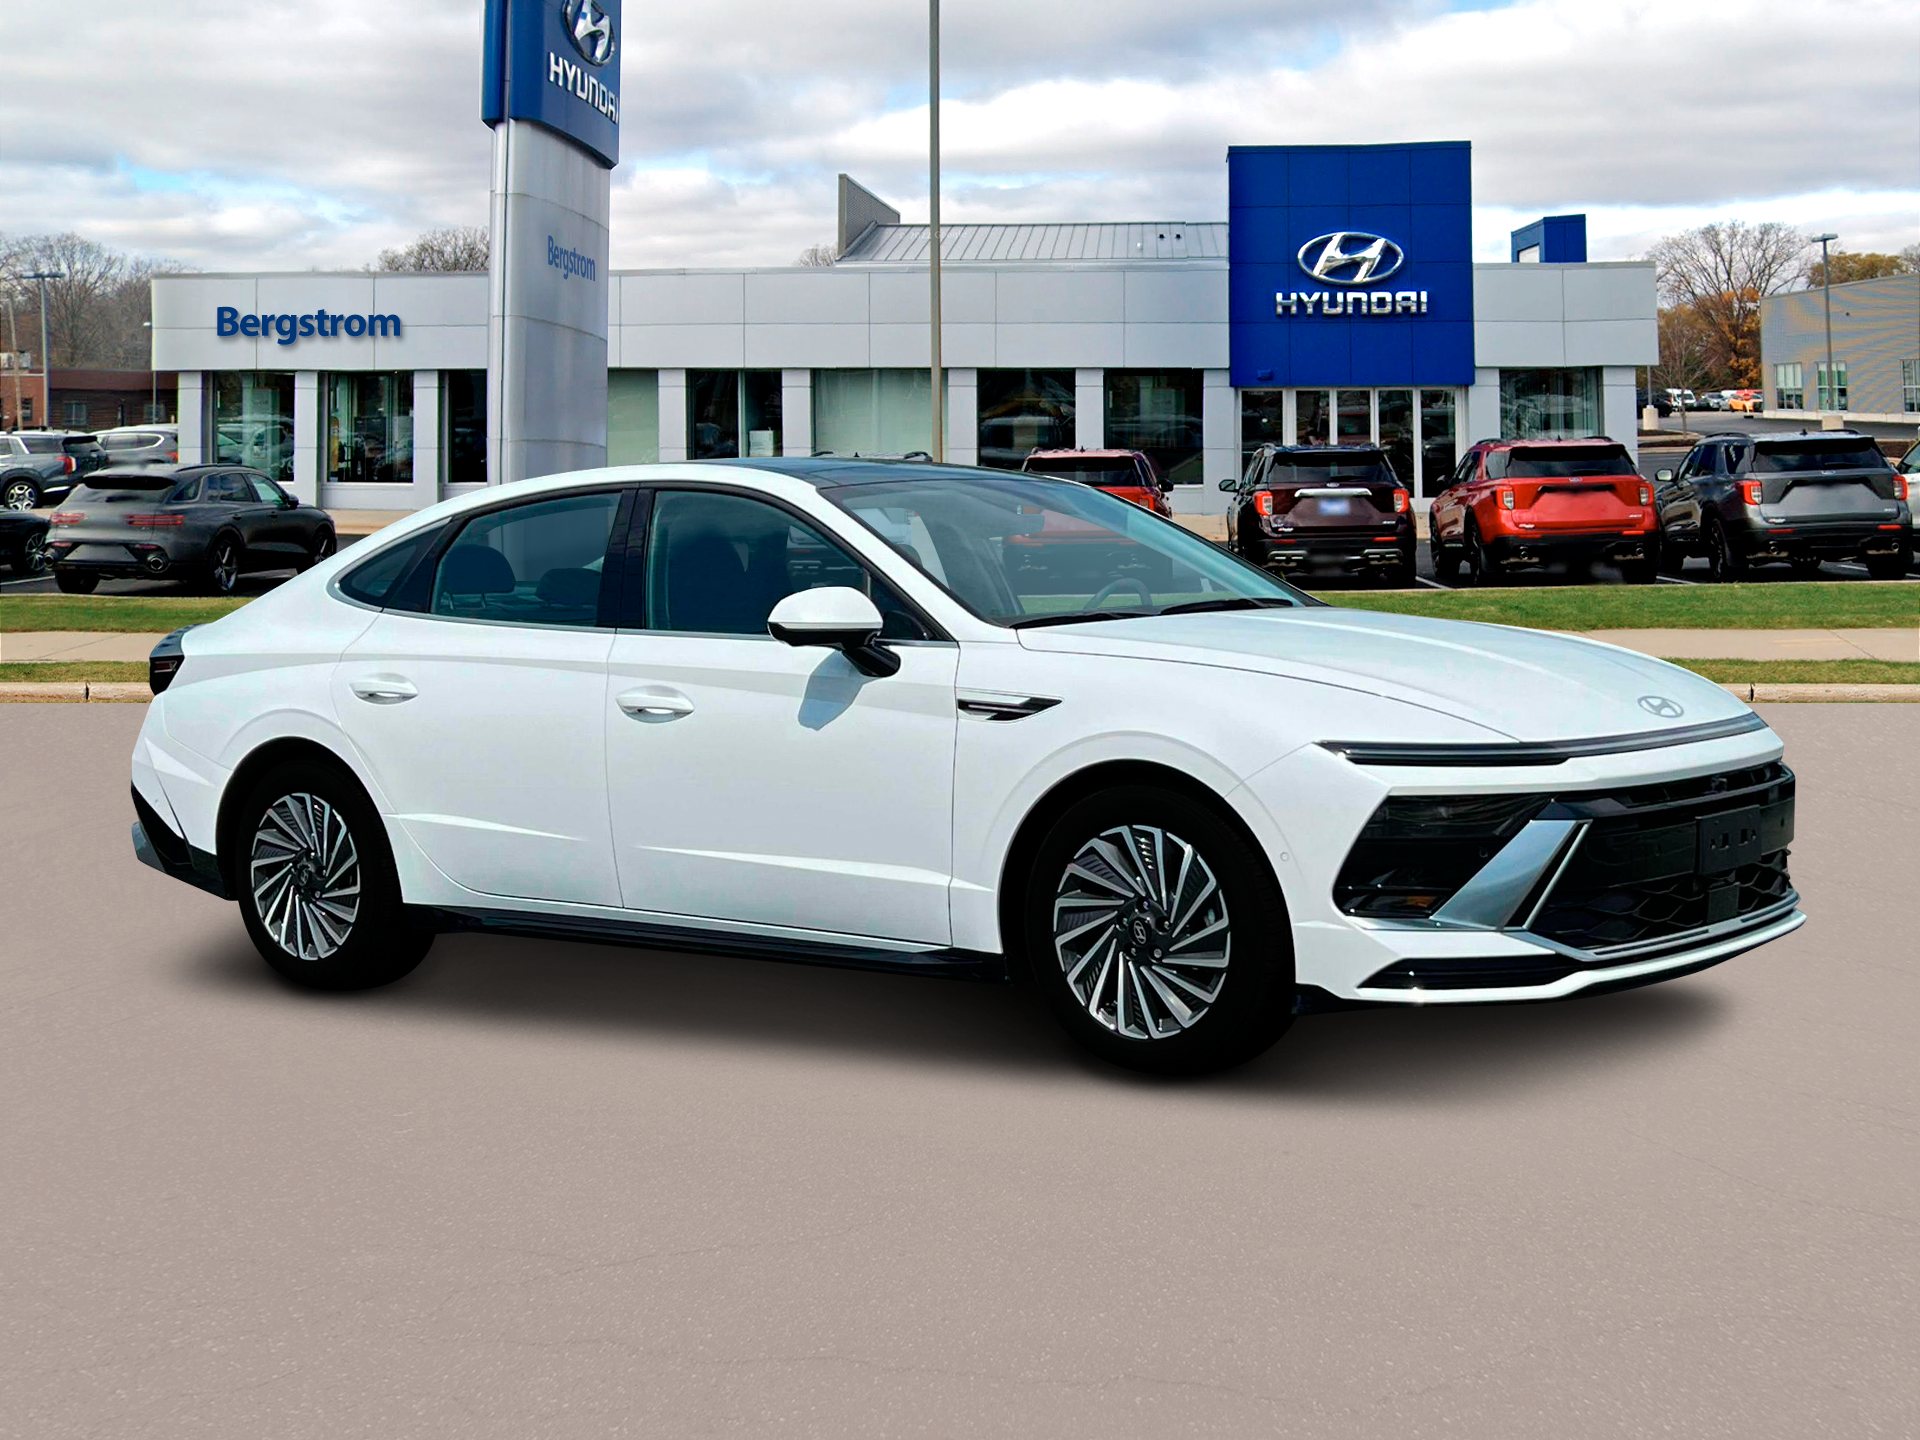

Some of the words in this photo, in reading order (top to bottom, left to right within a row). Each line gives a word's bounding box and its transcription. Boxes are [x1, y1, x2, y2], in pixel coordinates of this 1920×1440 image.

[548, 52, 618, 124] HYUNDAI
[547, 235, 596, 281] Bergstrom
[1275, 290, 1429, 315] HYUNDAI
[216, 306, 402, 346] Bergstrom
